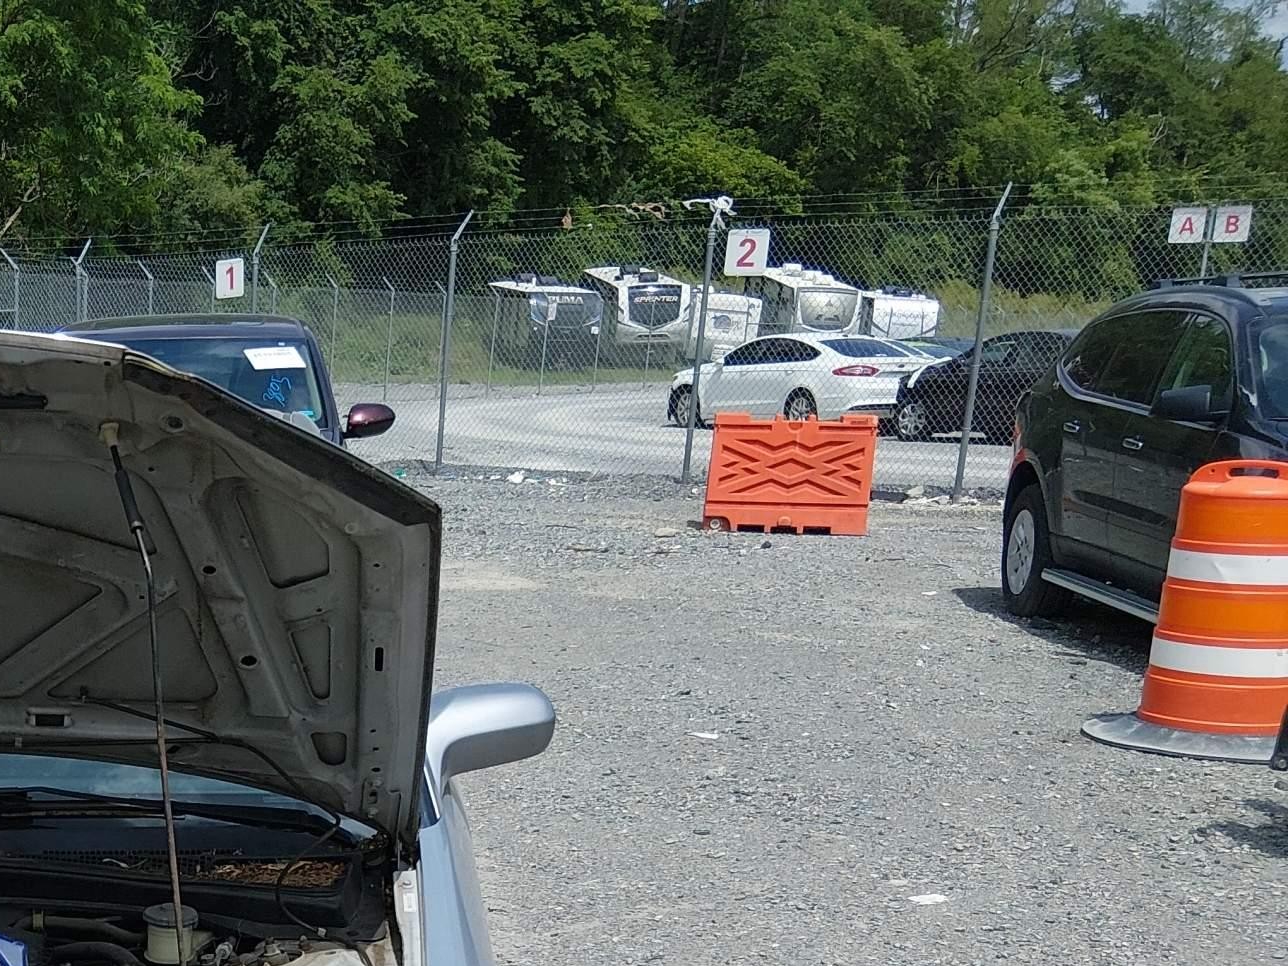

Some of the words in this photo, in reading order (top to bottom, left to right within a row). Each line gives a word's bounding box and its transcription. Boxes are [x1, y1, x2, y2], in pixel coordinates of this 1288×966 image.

[1179, 216, 1194, 235] A
[1225, 215, 1240, 234] B
[736, 238, 757, 267] 2
[225, 265, 234, 290] 1
[633, 295, 679, 304] SPRINTER
